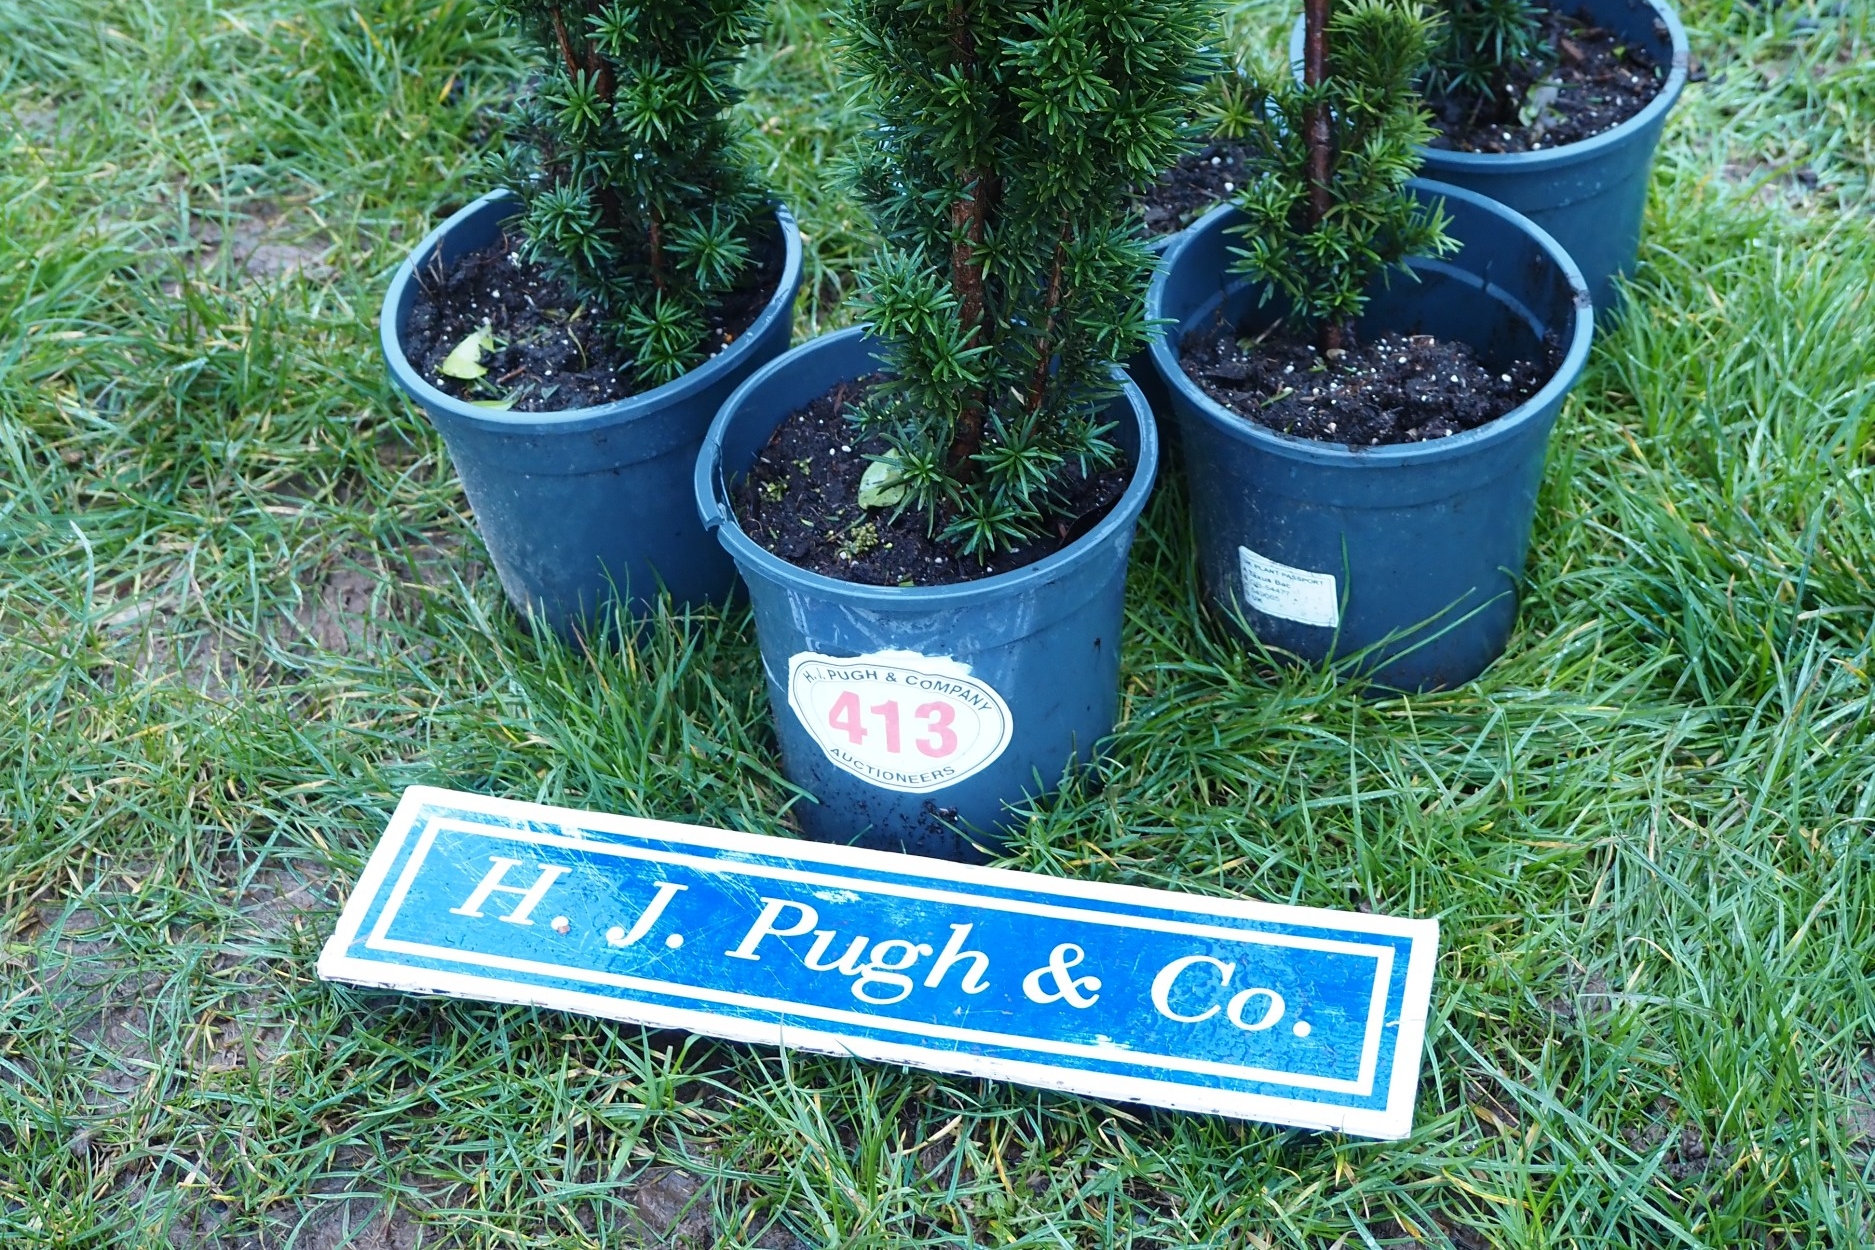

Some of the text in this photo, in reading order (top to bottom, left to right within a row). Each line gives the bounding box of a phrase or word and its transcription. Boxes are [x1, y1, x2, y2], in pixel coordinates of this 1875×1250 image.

[1254, 563, 1279, 576] PLANT
[1281, 572, 1324, 586] PASSPORT
[885, 671, 898, 683] &
[905, 675, 993, 712] COMPANY
[828, 690, 958, 759] 413
[830, 748, 956, 784] AUCTIONEERS
[448, 855, 1312, 1038] H. J. Pugh & Co.
